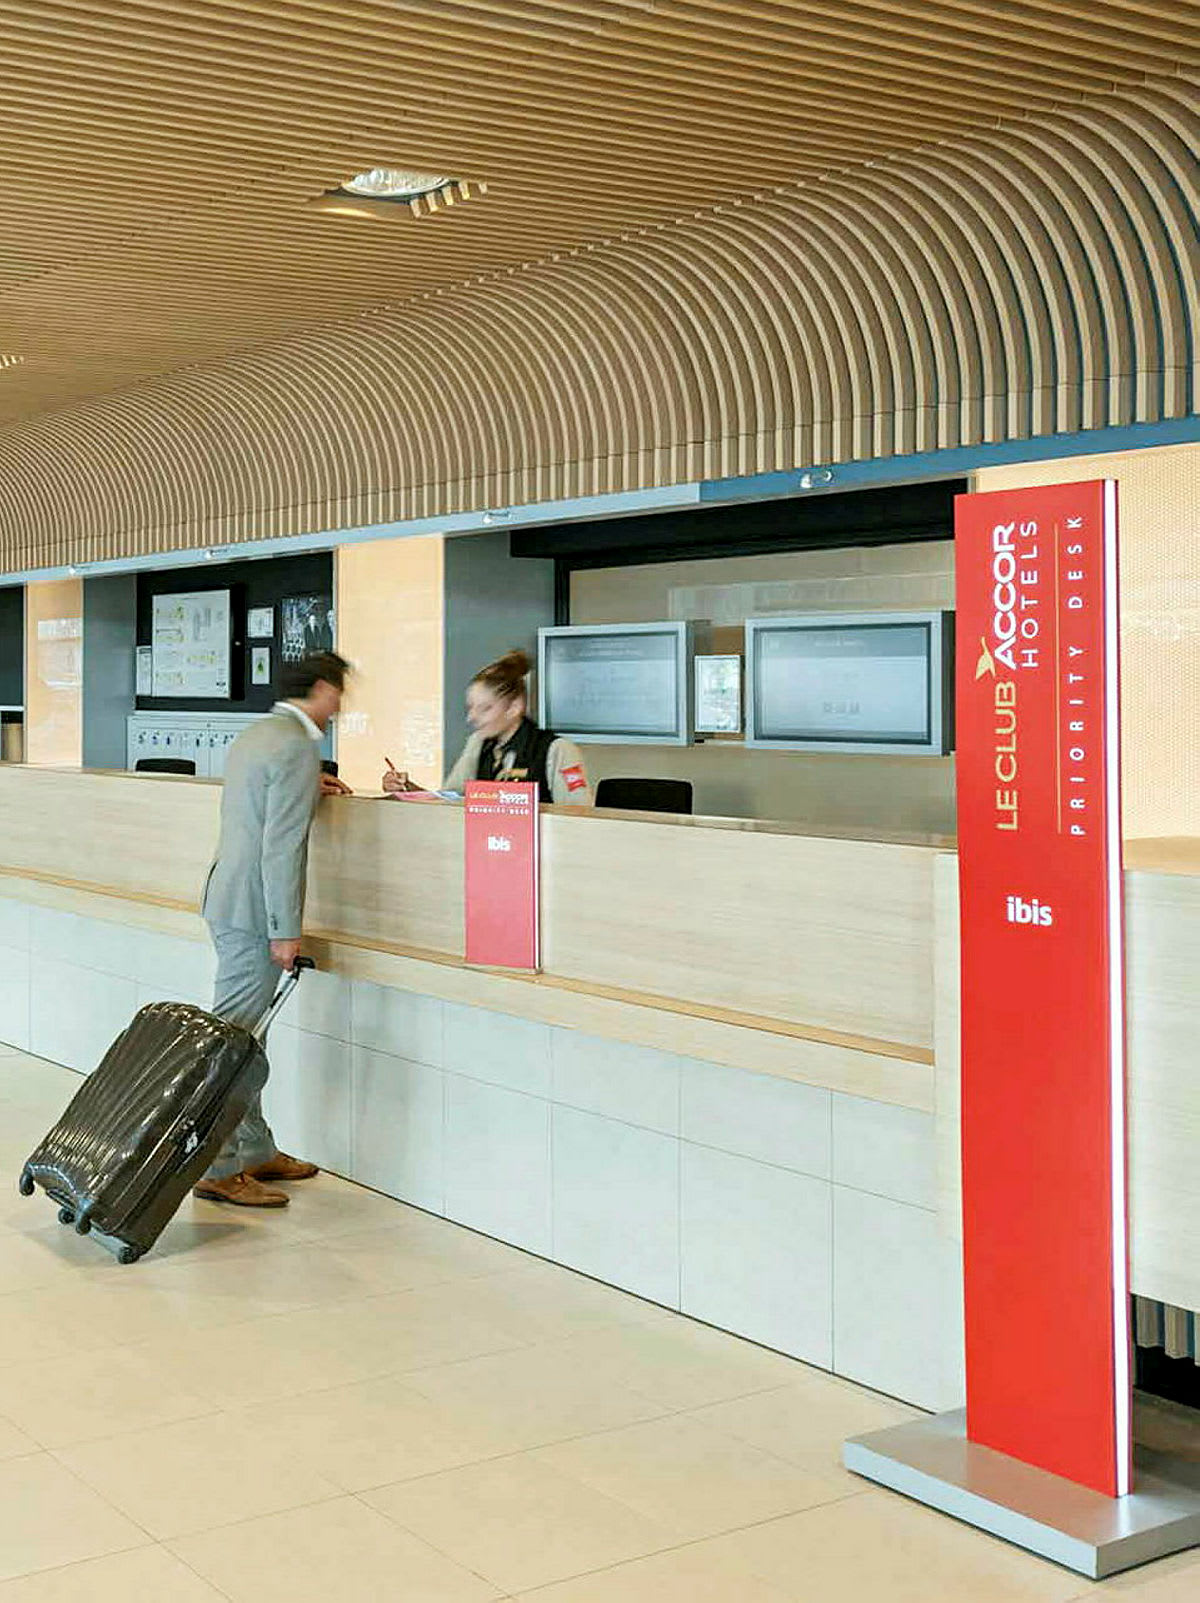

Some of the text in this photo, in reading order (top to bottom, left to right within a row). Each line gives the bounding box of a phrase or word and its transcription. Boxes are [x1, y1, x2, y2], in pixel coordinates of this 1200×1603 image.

[993, 522, 1018, 830] LE CLUB ACCOR
[1020, 521, 1039, 667] HOTELS
[1066, 516, 1086, 836] PRIORITY DESK
[1006, 896, 1052, 926] ibis
